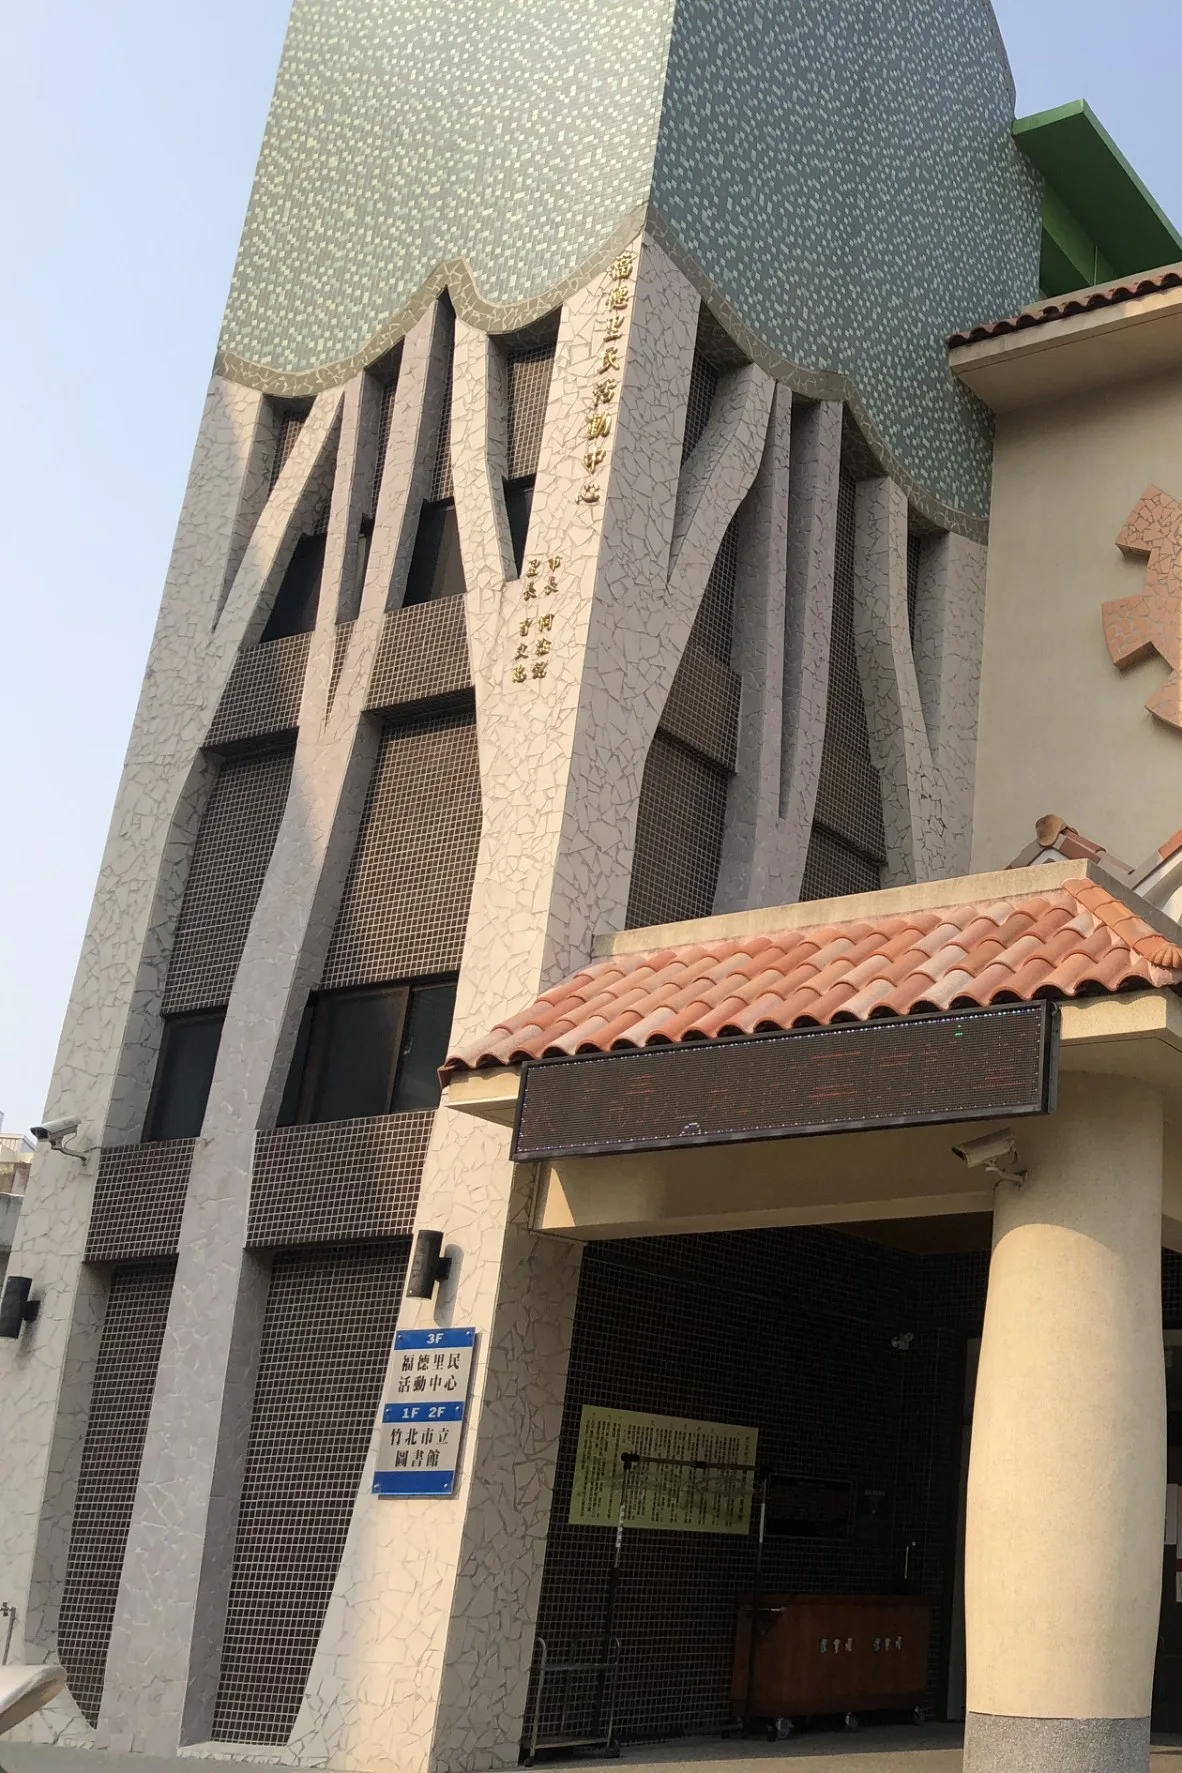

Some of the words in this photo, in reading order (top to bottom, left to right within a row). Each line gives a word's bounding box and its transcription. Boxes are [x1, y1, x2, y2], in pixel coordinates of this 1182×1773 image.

[575, 255, 636, 505] 福德里民活動中心
[523, 558, 541, 602] 里長
[543, 555, 564, 597] 市長
[426, 1333, 444, 1344] 3F
[401, 1352, 461, 1372] 福德里民
[397, 1374, 458, 1393] 活動中心
[401, 1407, 421, 1419] 1F
[427, 1406, 447, 1418] 2F
[390, 1427, 450, 1446] 竹北市立
[394, 1449, 441, 1468] 圖書館
